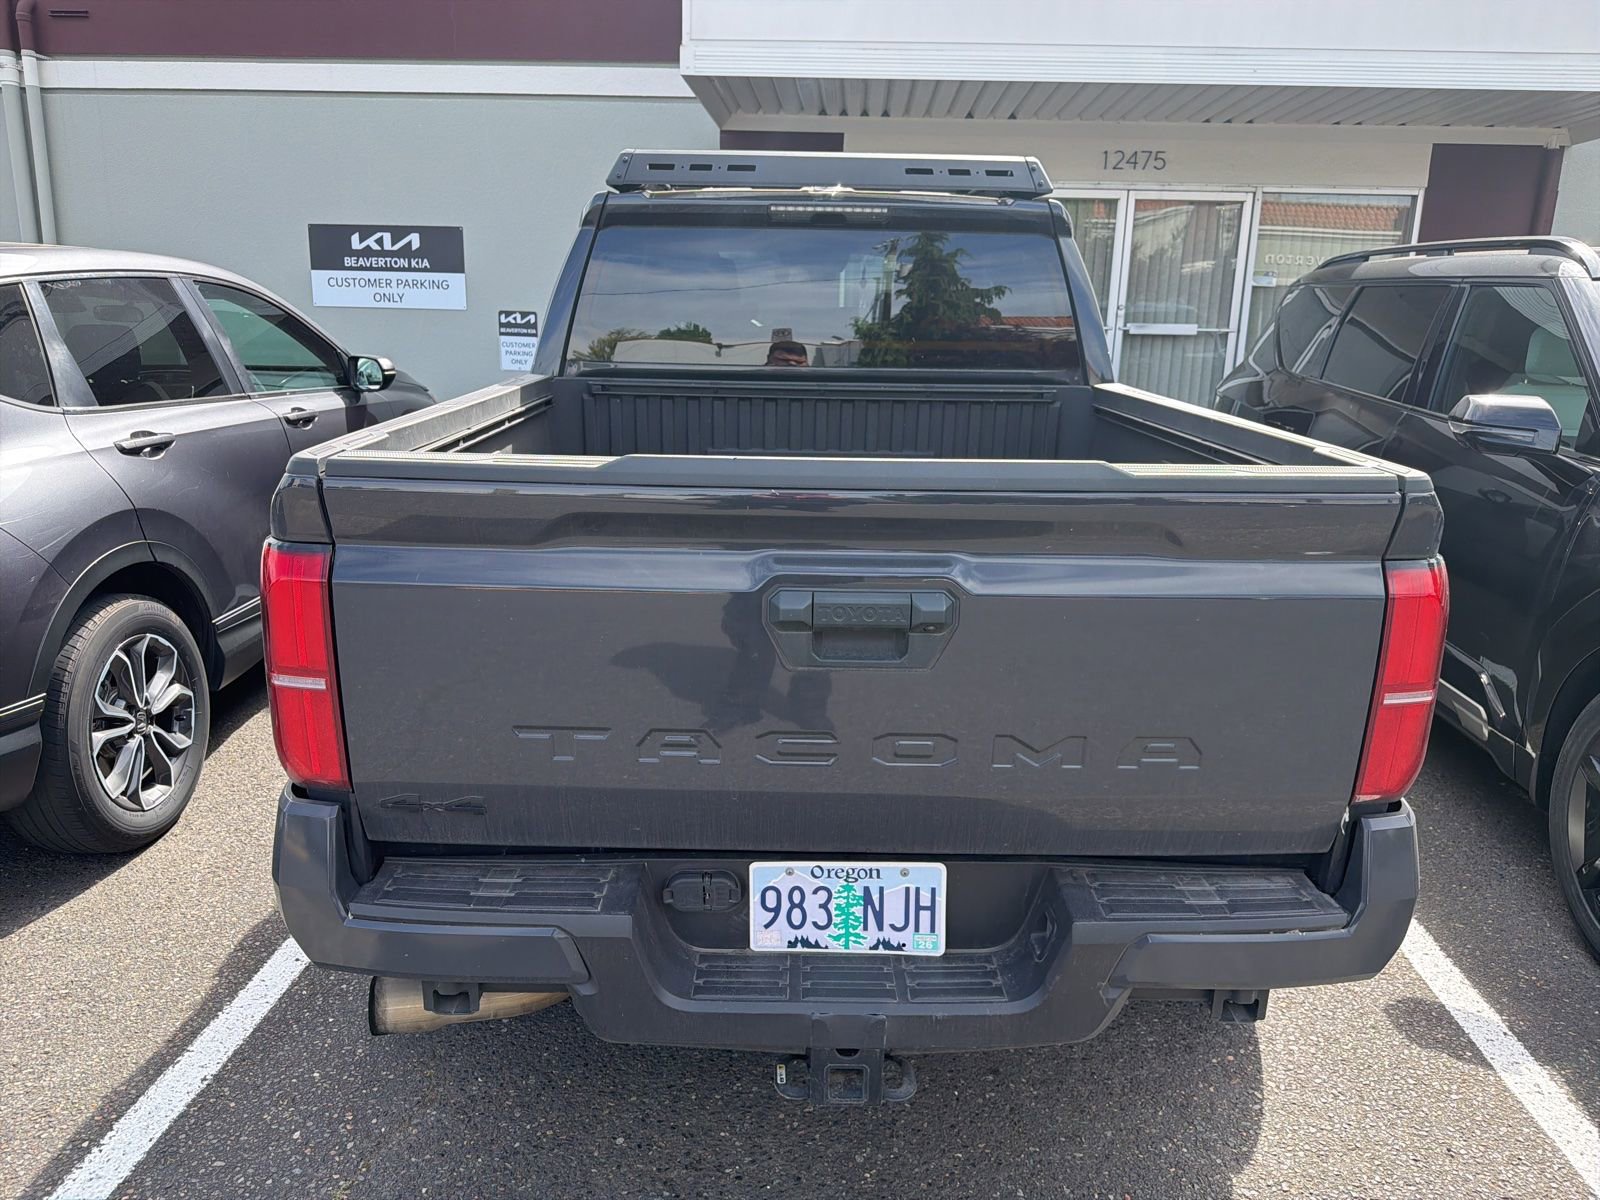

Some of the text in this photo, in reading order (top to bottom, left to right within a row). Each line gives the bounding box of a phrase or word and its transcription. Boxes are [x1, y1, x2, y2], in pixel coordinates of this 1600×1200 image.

[1102, 150, 1166, 171] 12475
[344, 257, 430, 269] BEAVERTON KIA
[327, 277, 450, 290] CUSTOMER PARKING
[373, 292, 405, 304] ONLY
[501, 341, 536, 349] CUSTOMER
[817, 606, 907, 622] TOYOTA
[511, 724, 1203, 769] TACOMA
[810, 865, 883, 884] Oregon
[760, 885, 936, 933] 983 NJH
[918, 941, 933, 949] 26
